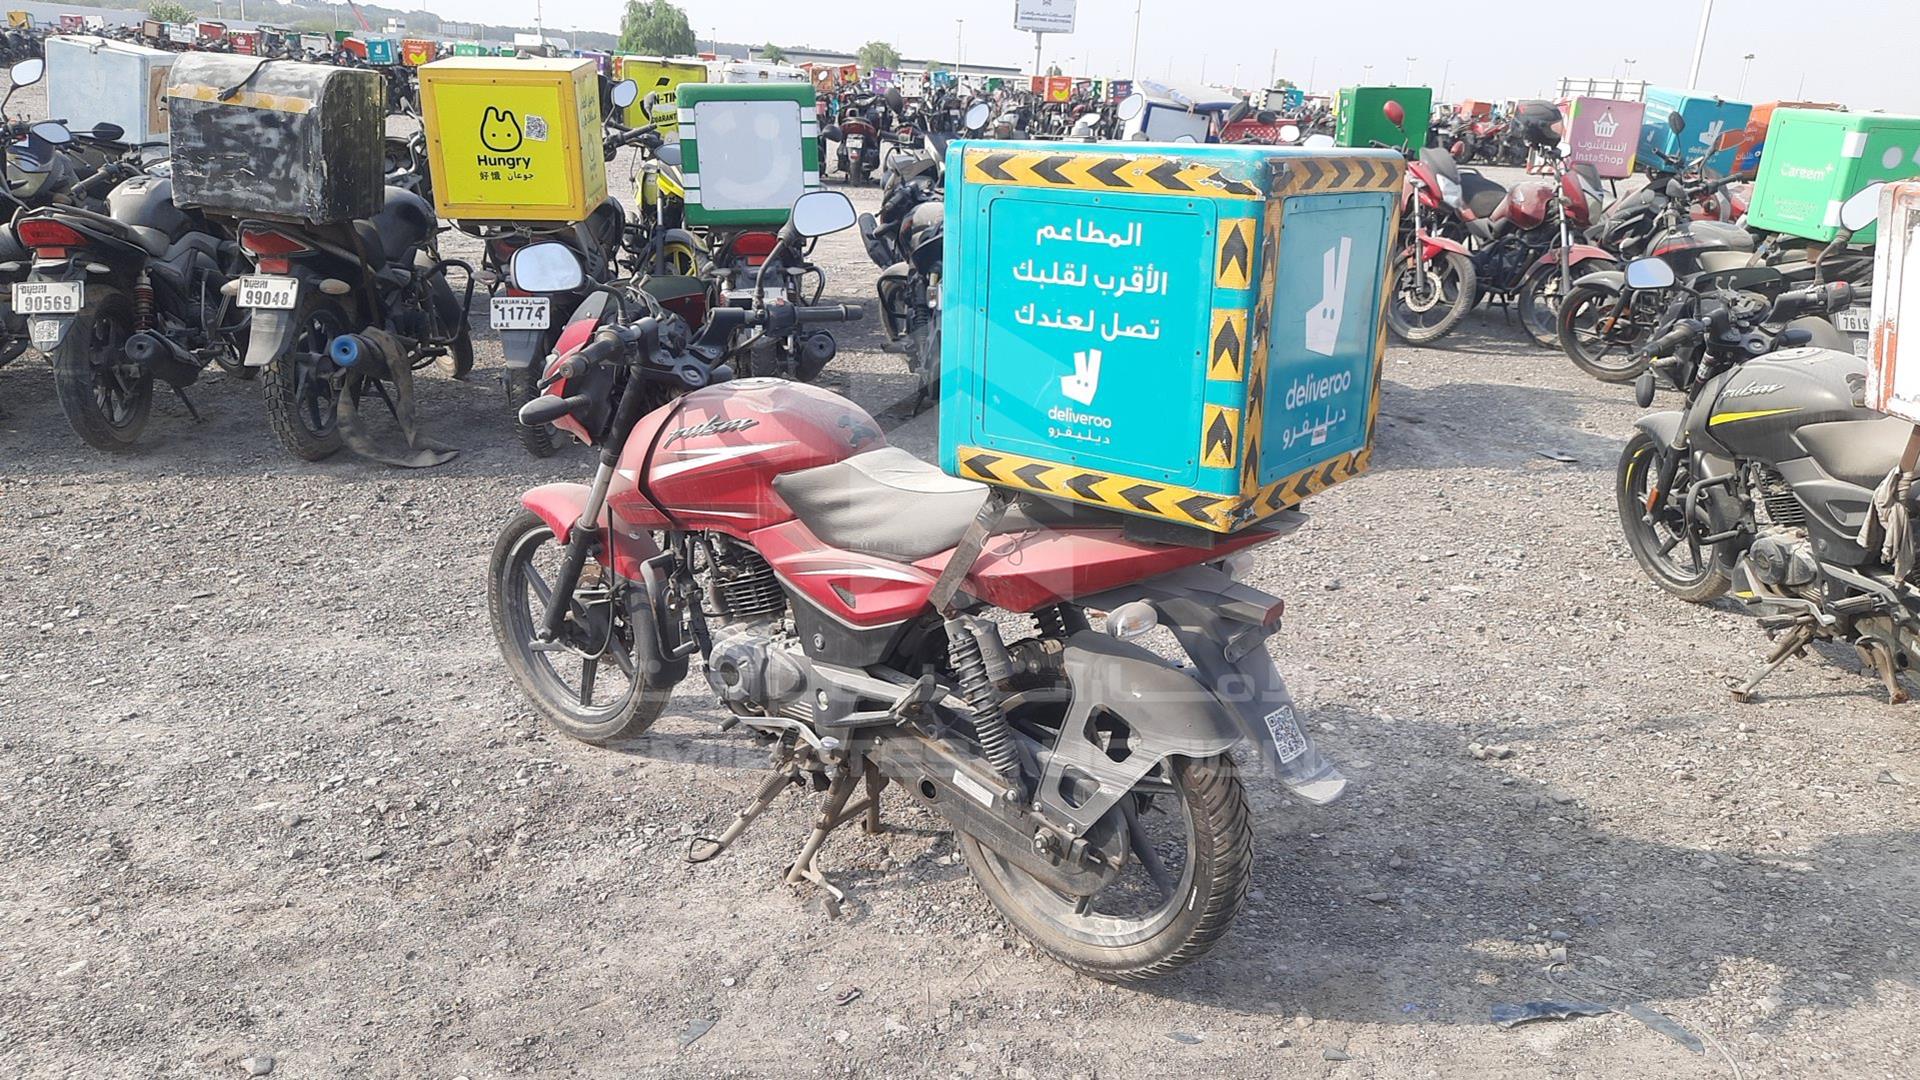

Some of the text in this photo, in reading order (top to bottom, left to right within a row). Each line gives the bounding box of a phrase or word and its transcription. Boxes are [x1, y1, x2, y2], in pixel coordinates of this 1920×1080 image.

[477, 154, 531, 169] Hungry
[1575, 151, 1624, 165] InstaShop
[1036, 218, 1143, 248] المطاعم
[1012, 258, 1168, 298] الأقرب لقلبك
[25, 295, 72, 312] 90569
[245, 290, 289, 306] 99048
[498, 306, 544, 321] 11774
[1014, 302, 1161, 342] تصل لعندك
[1285, 369, 1352, 411] deliveroo
[1047, 405, 1112, 428] deliveroo
